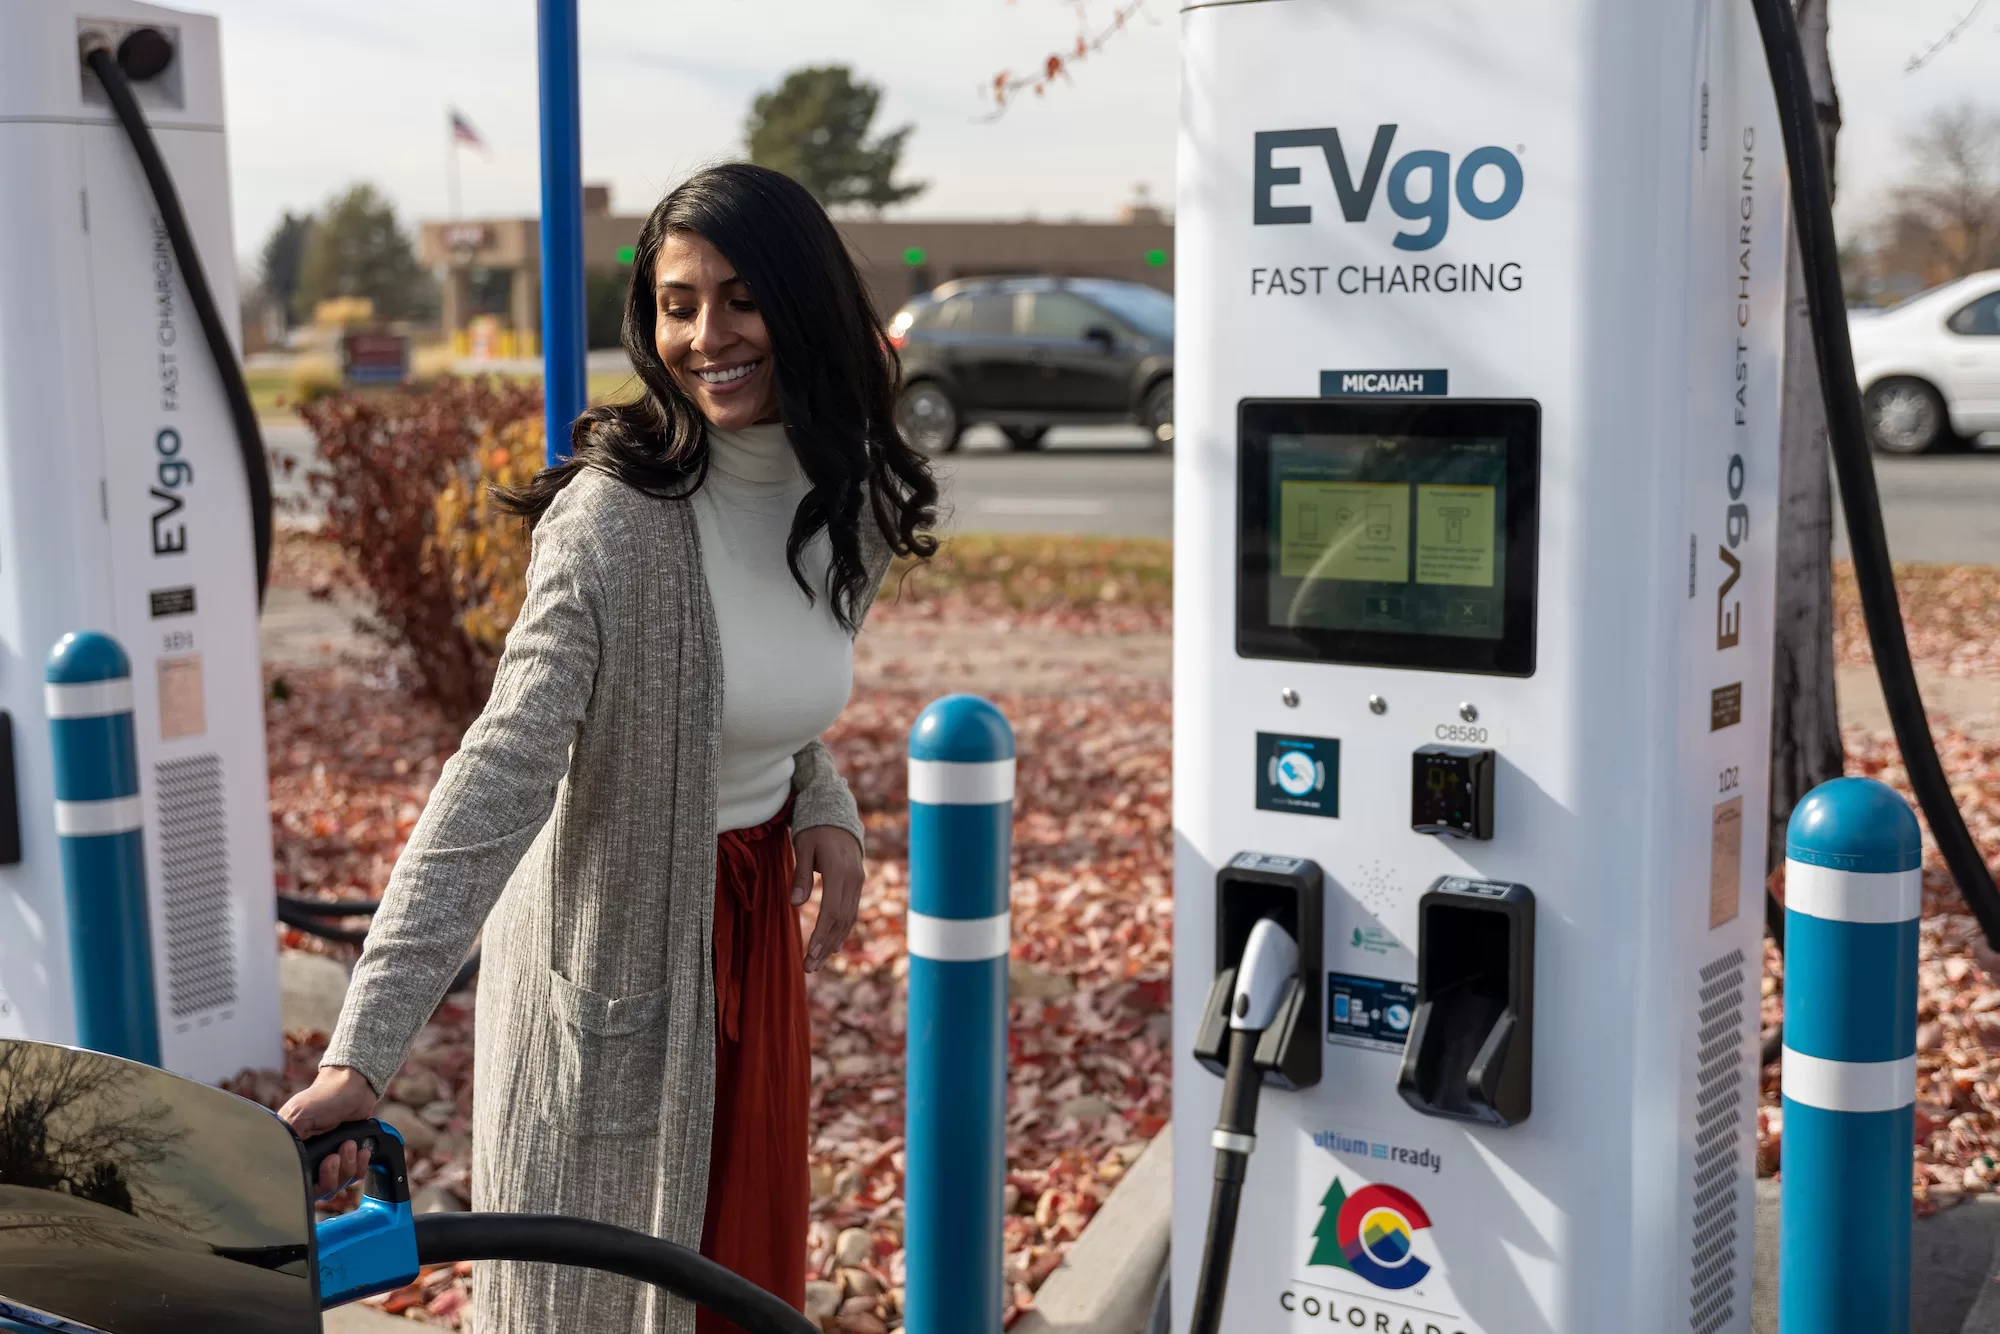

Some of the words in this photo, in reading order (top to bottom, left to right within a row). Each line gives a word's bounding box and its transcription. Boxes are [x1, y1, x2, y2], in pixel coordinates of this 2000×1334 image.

[1254, 123, 1524, 252] EVgo
[1737, 126, 1756, 328] CHARGING
[1251, 267, 1329, 295] FAST
[1338, 262, 1523, 294] CHARGING
[160, 352, 180, 412] FAST
[1342, 374, 1424, 392] MICAIAH
[1734, 338, 1751, 426] FAST
[149, 428, 194, 554] EVgo
[1716, 453, 1748, 651] EVgo
[1435, 724, 1488, 743] C8580
[1314, 1130, 1368, 1155] ultium
[1391, 1147, 1441, 1173] ready
[1279, 1291, 1469, 1334] COLORAD
